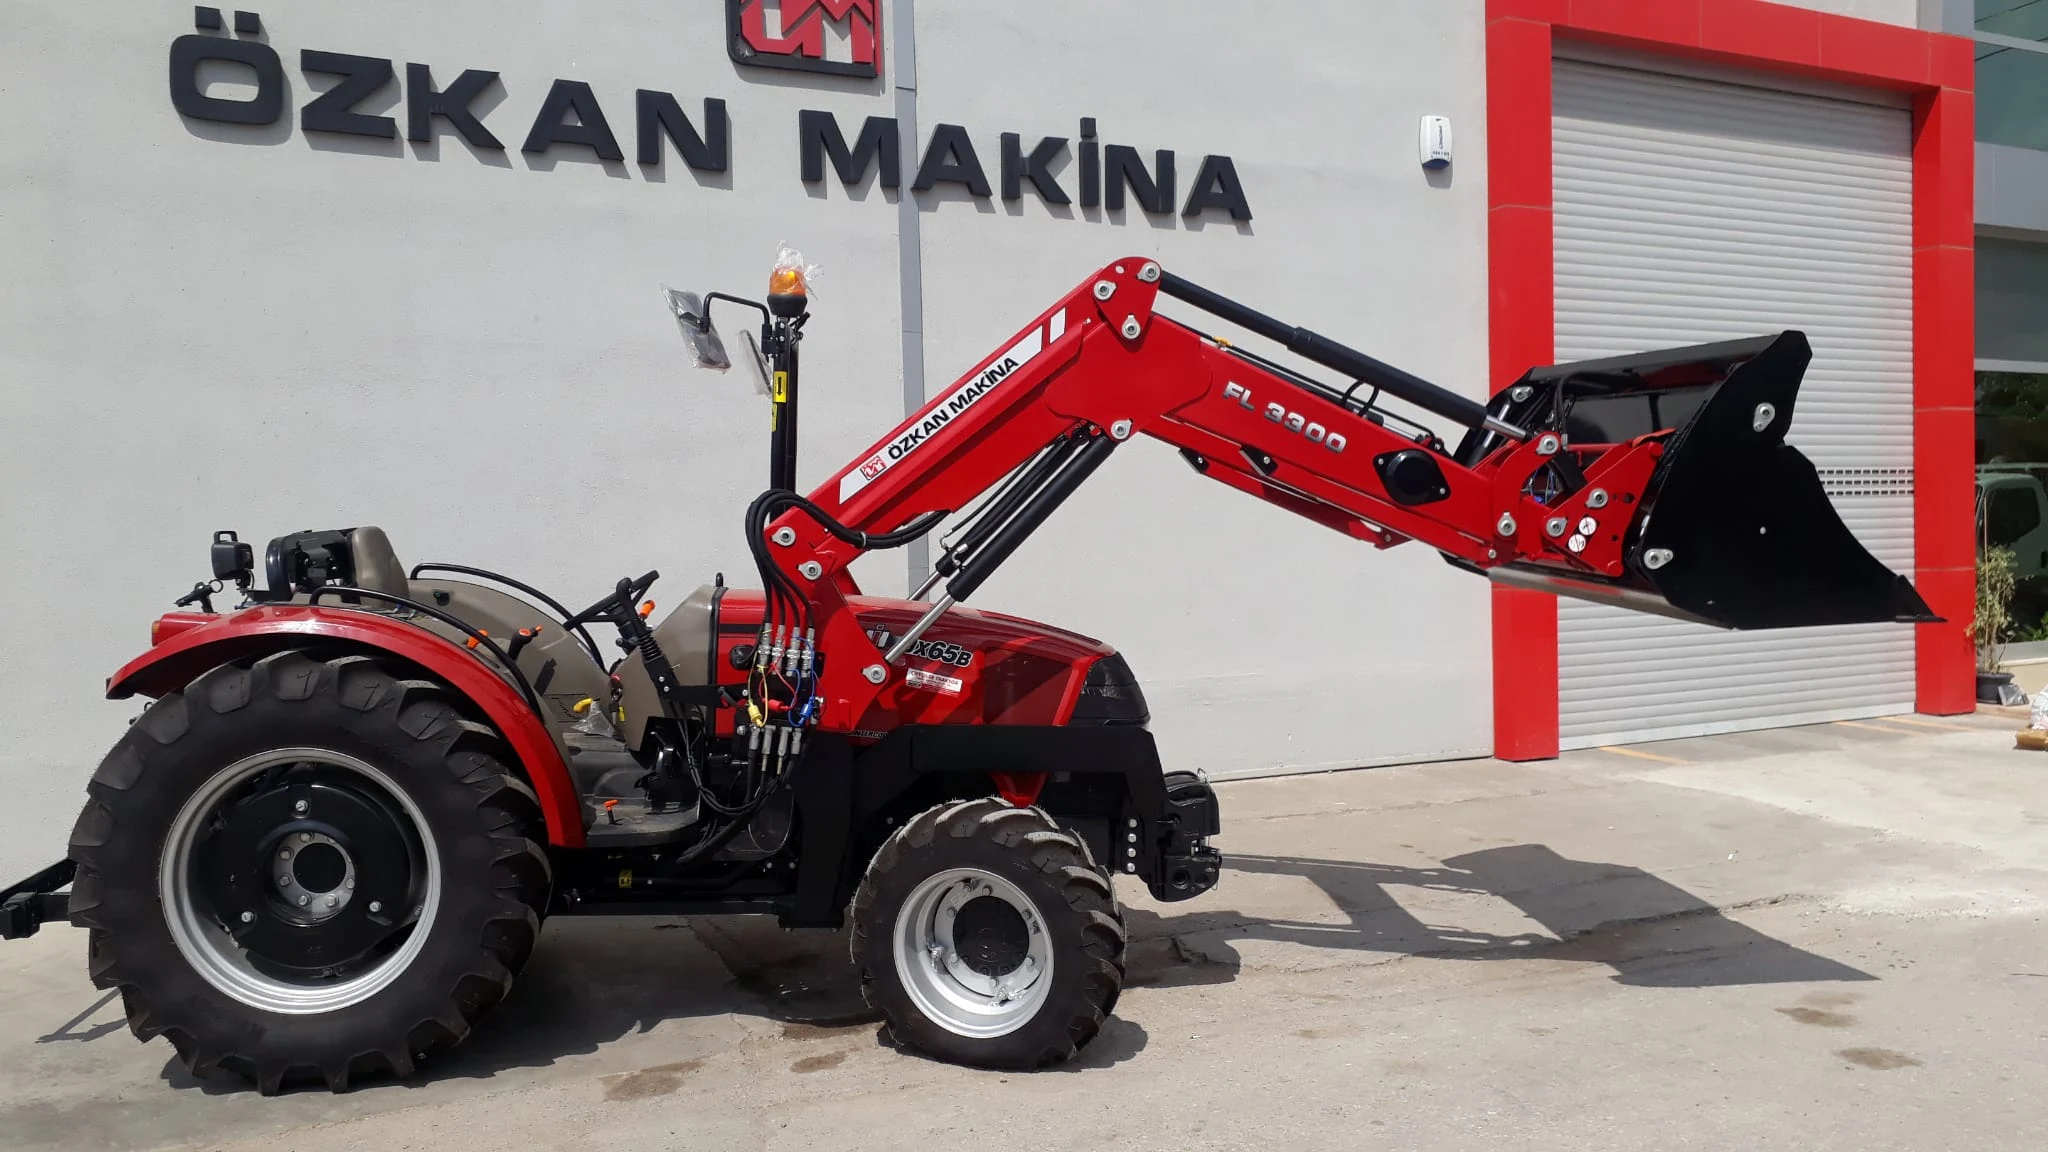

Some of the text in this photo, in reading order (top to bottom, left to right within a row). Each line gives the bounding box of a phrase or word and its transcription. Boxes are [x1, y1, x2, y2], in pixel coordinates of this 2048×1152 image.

[169, 6, 727, 172] ÖZKAN
[799, 109, 1253, 221] MAKİNA
[887, 357, 1020, 460] ÖZKAN MAKİNA
[1223, 381, 1347, 453] FL 3300
